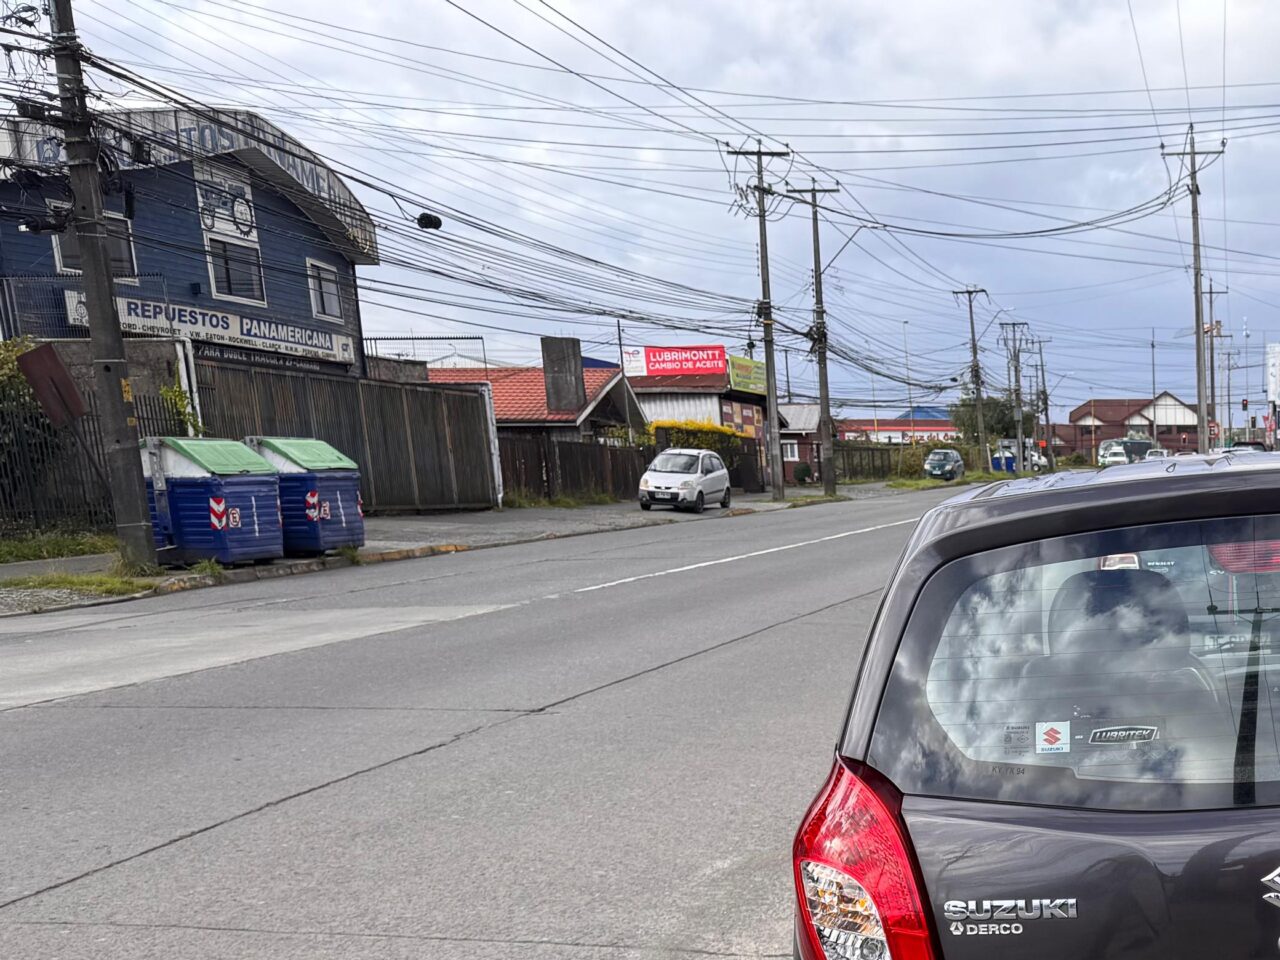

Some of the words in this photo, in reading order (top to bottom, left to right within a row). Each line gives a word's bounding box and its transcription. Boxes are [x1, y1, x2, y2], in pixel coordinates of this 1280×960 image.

[126, 301, 230, 330] REPUESTOS
[242, 318, 333, 350] PANAMERICANA
[650, 350, 721, 362] LUBRIMONTT
[648, 360, 681, 370] CAMBIO
[683, 360, 694, 369] DE
[695, 358, 724, 369] ACEITE
[1095, 729, 1151, 742] LUBRITEK
[943, 898, 1078, 921] SUZUKI
[966, 923, 1024, 935] DERCO
